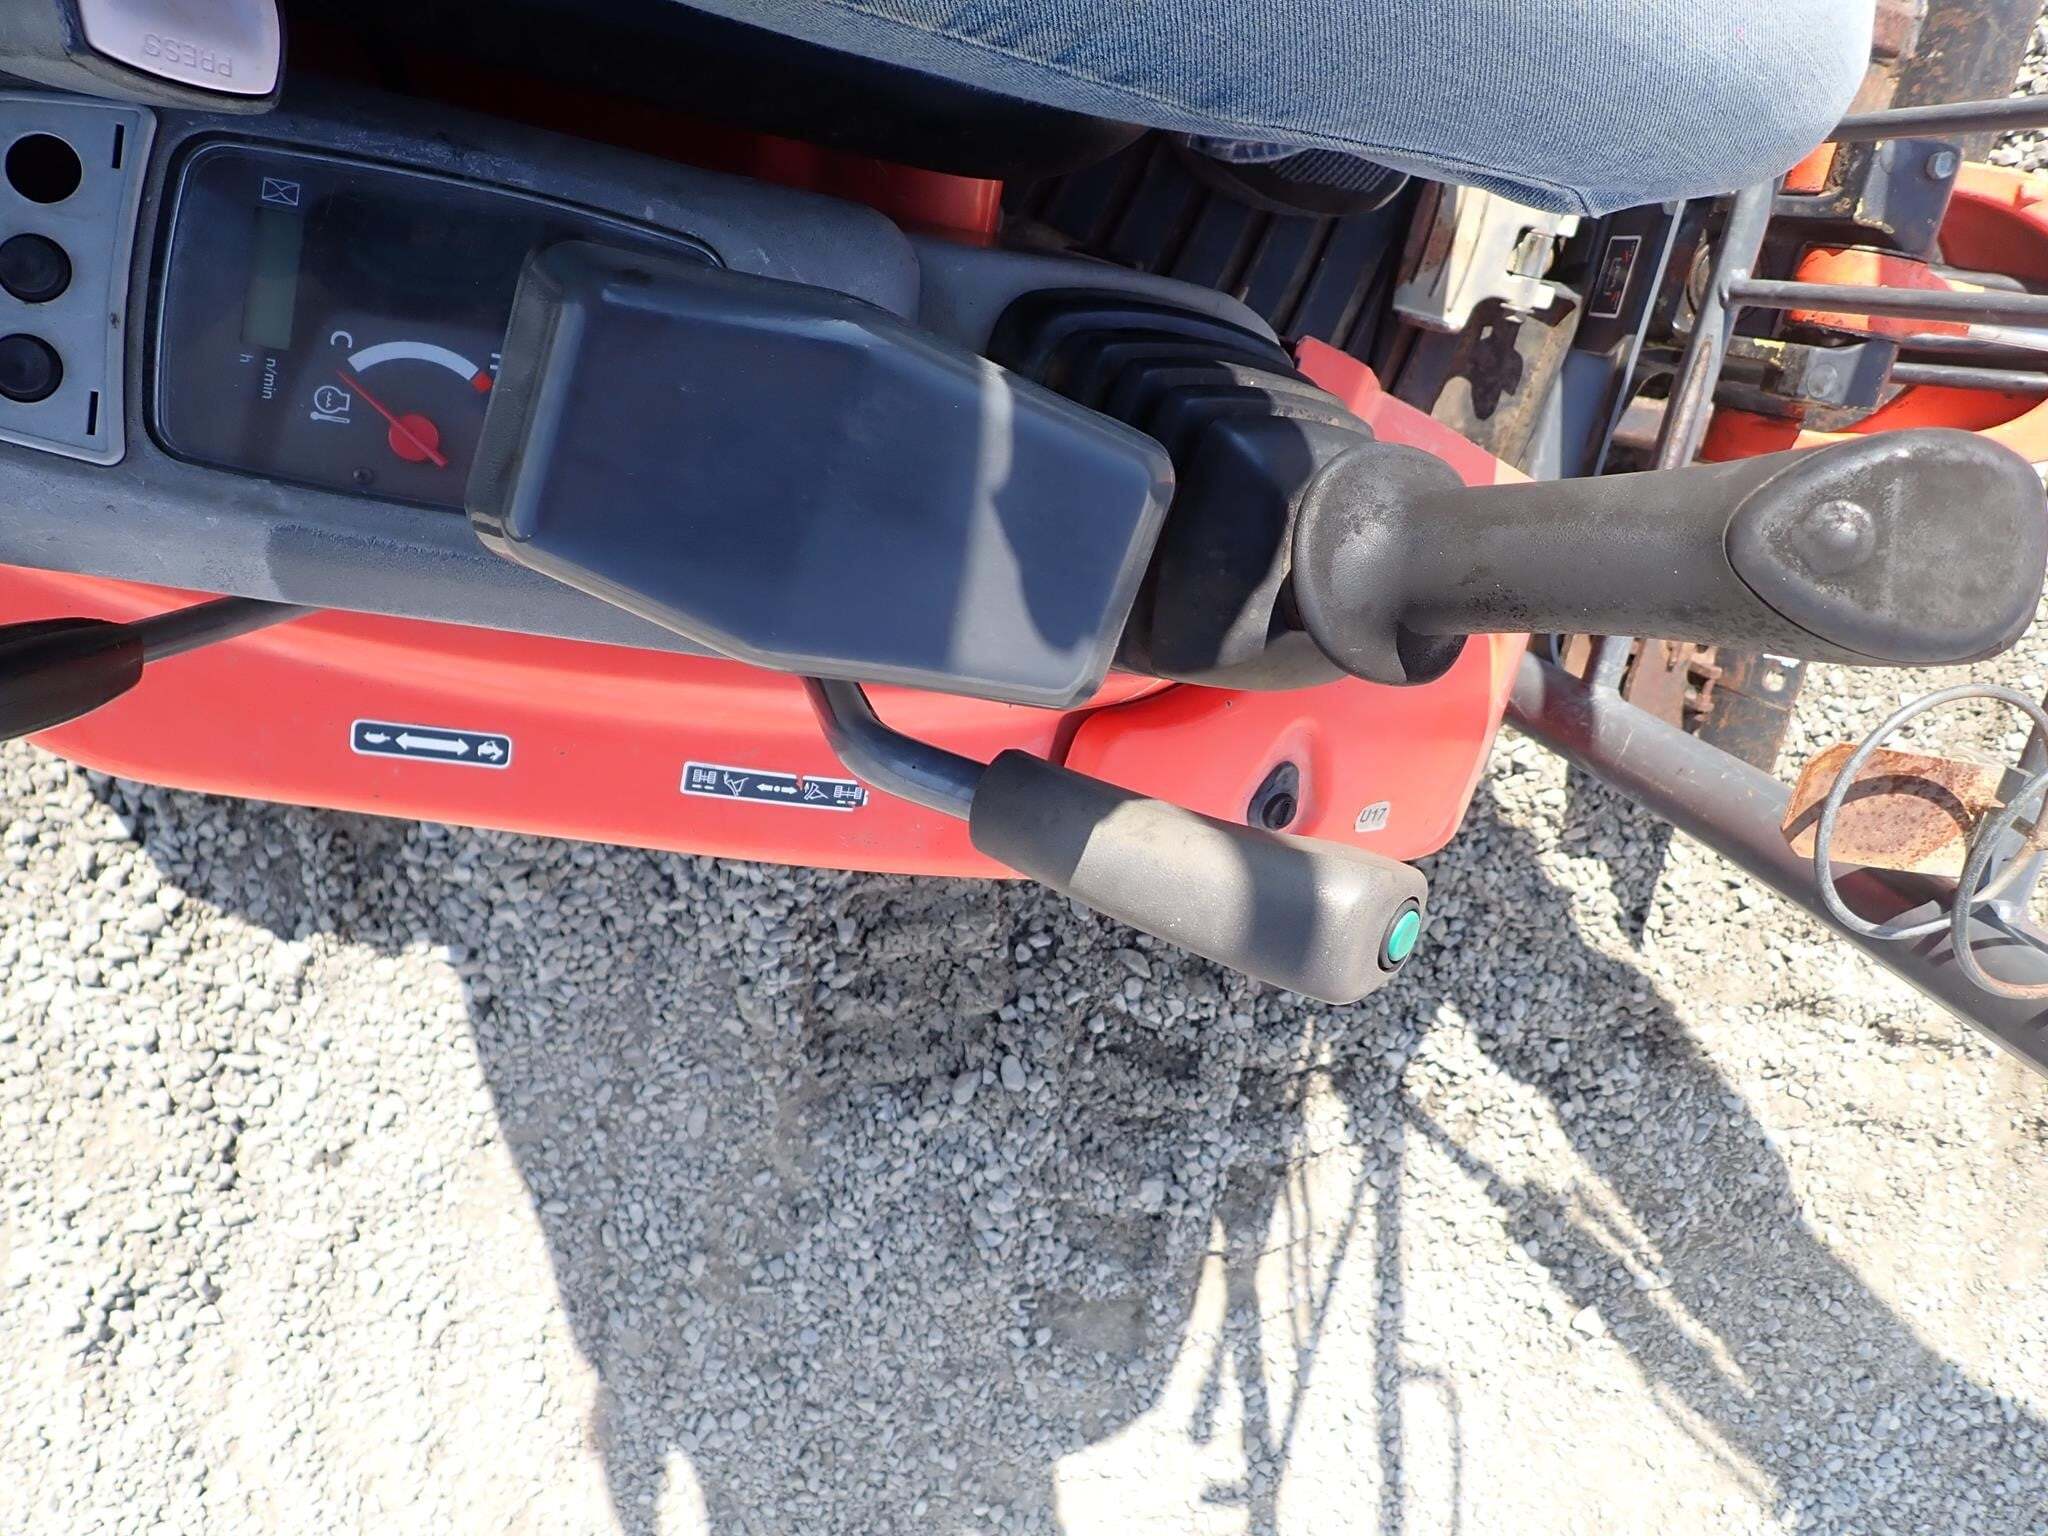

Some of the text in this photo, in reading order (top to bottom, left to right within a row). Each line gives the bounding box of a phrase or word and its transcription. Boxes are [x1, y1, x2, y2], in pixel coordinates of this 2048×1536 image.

[144, 33, 232, 78] PRESS
[330, 330, 353, 348] C
[240, 353, 253, 363] h
[261, 358, 276, 400] n/min
